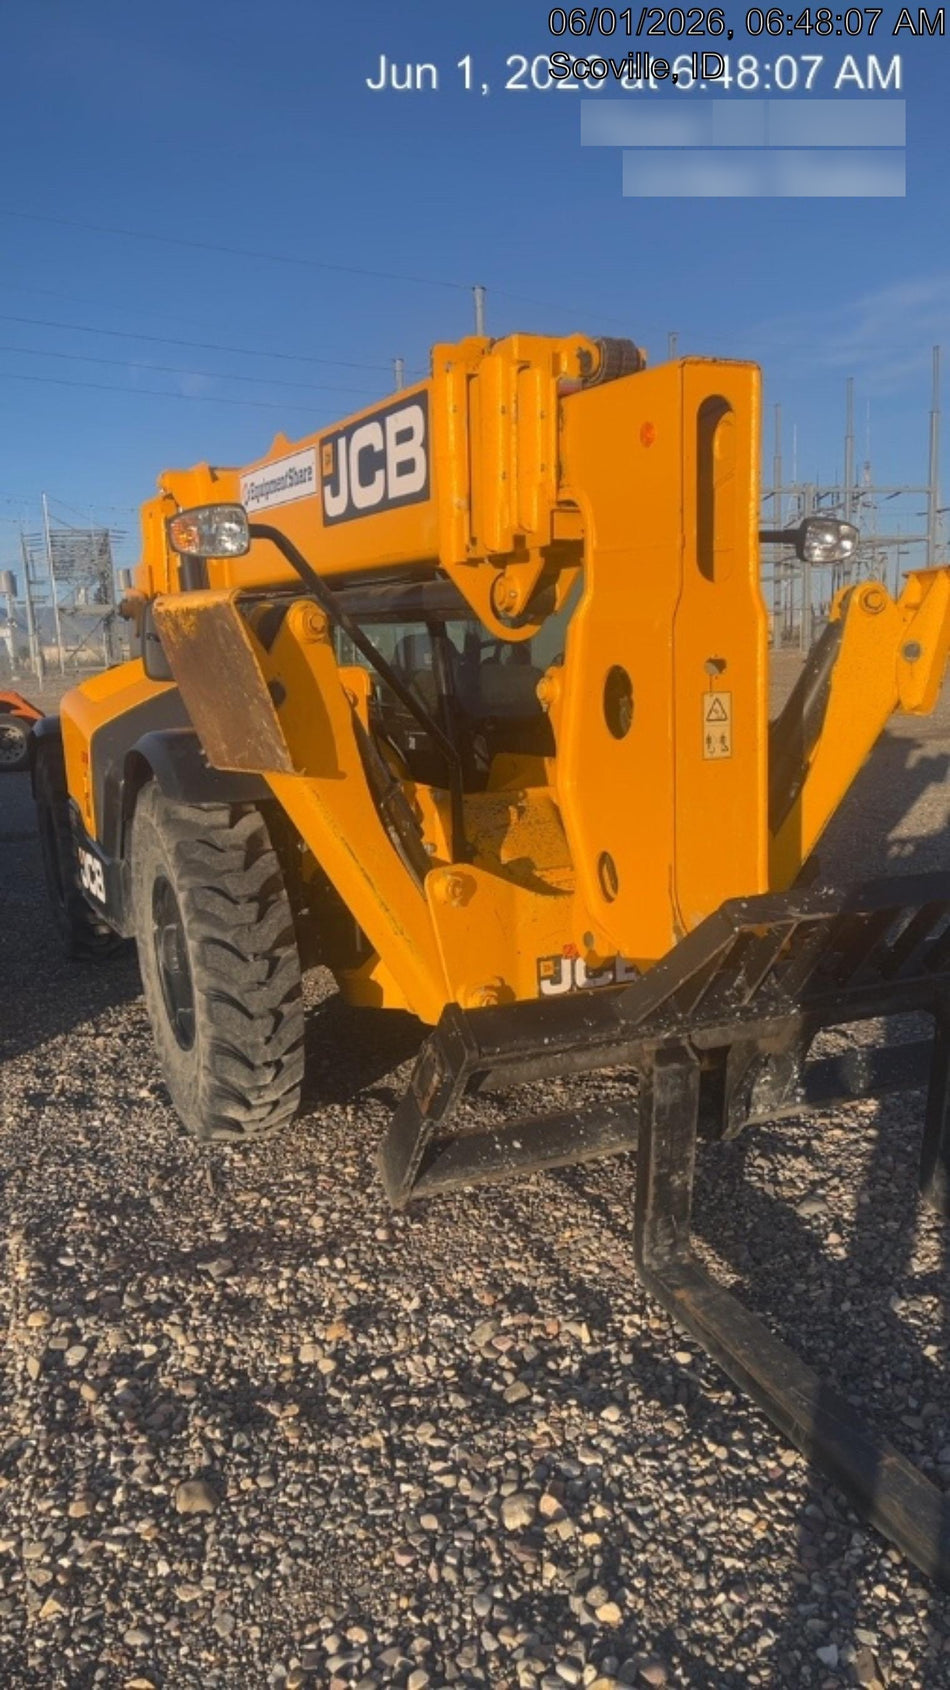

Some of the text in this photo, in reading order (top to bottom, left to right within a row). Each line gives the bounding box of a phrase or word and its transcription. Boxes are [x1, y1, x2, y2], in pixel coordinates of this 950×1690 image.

[250, 465, 313, 503] EquipmentShare
[324, 404, 427, 518] JCB
[80, 849, 106, 904] JCB
